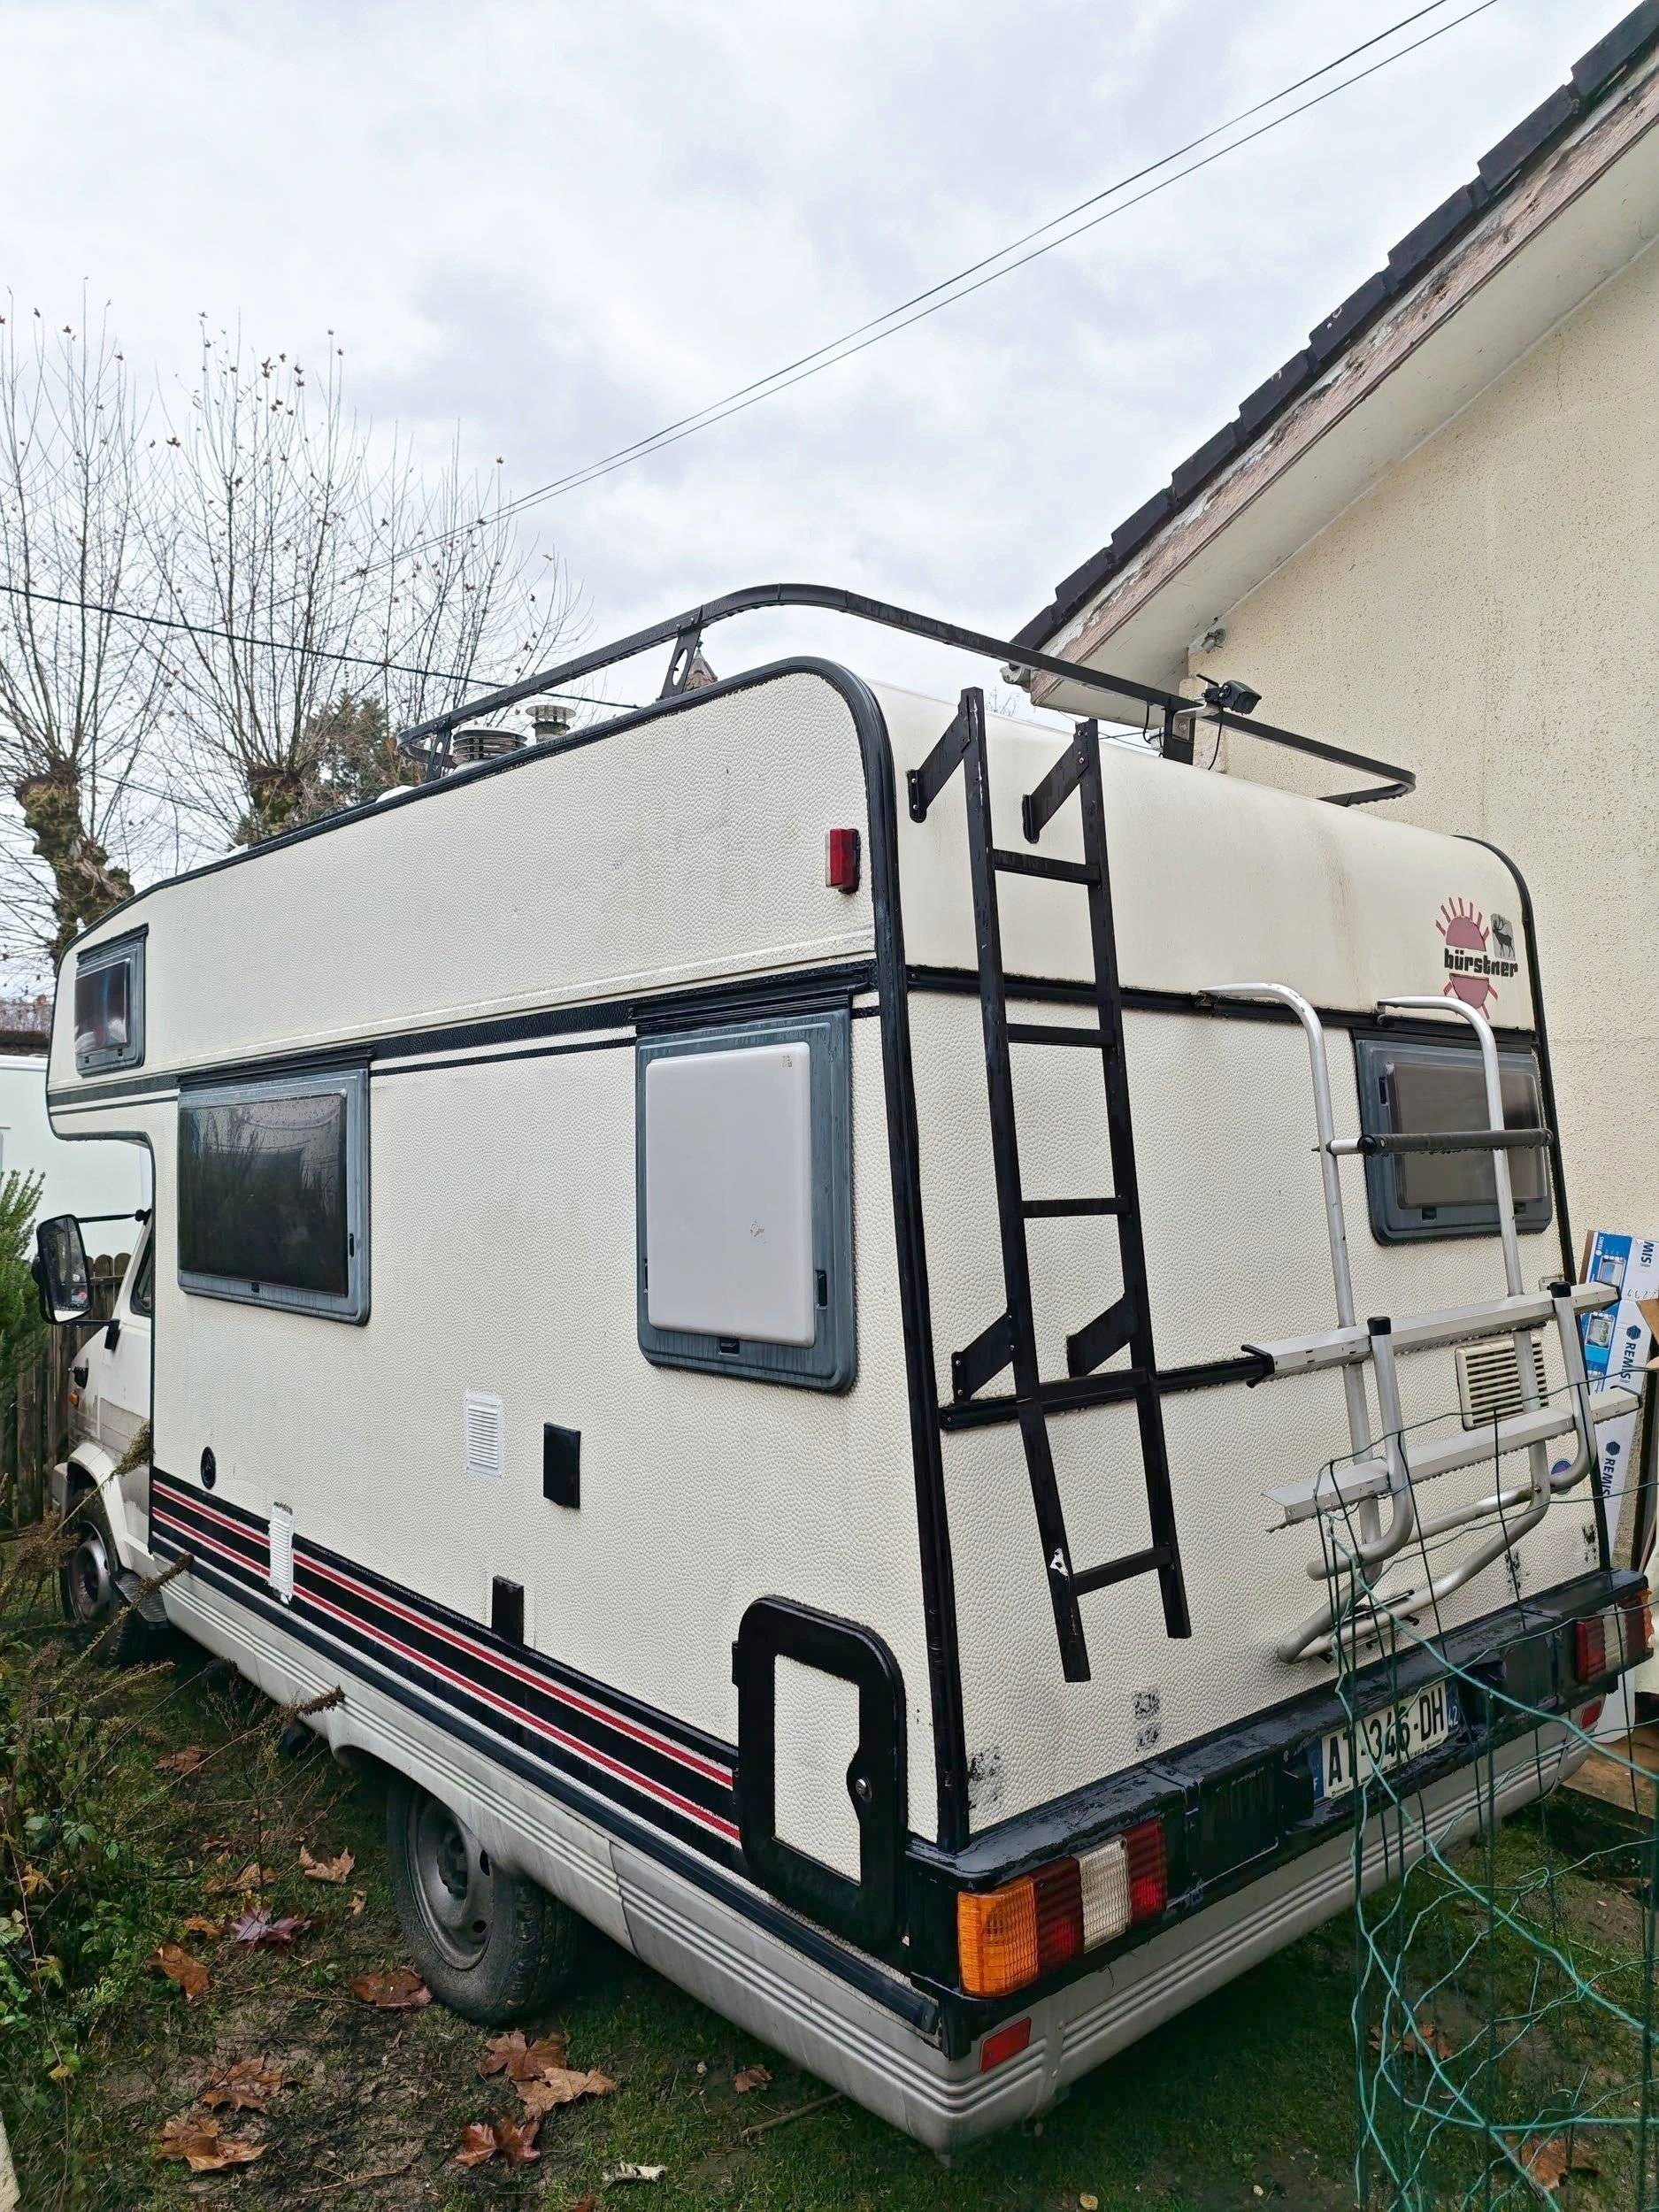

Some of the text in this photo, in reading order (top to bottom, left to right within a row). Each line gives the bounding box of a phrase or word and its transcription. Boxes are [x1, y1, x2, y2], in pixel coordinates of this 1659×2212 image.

[1444, 948, 1518, 977] bürstner
[1620, 1342, 1636, 1380] REMIS
[1601, 1457, 1616, 1495] REMIS
[1448, 1705, 1458, 1727] 42
[1313, 1778, 1318, 1792] F
